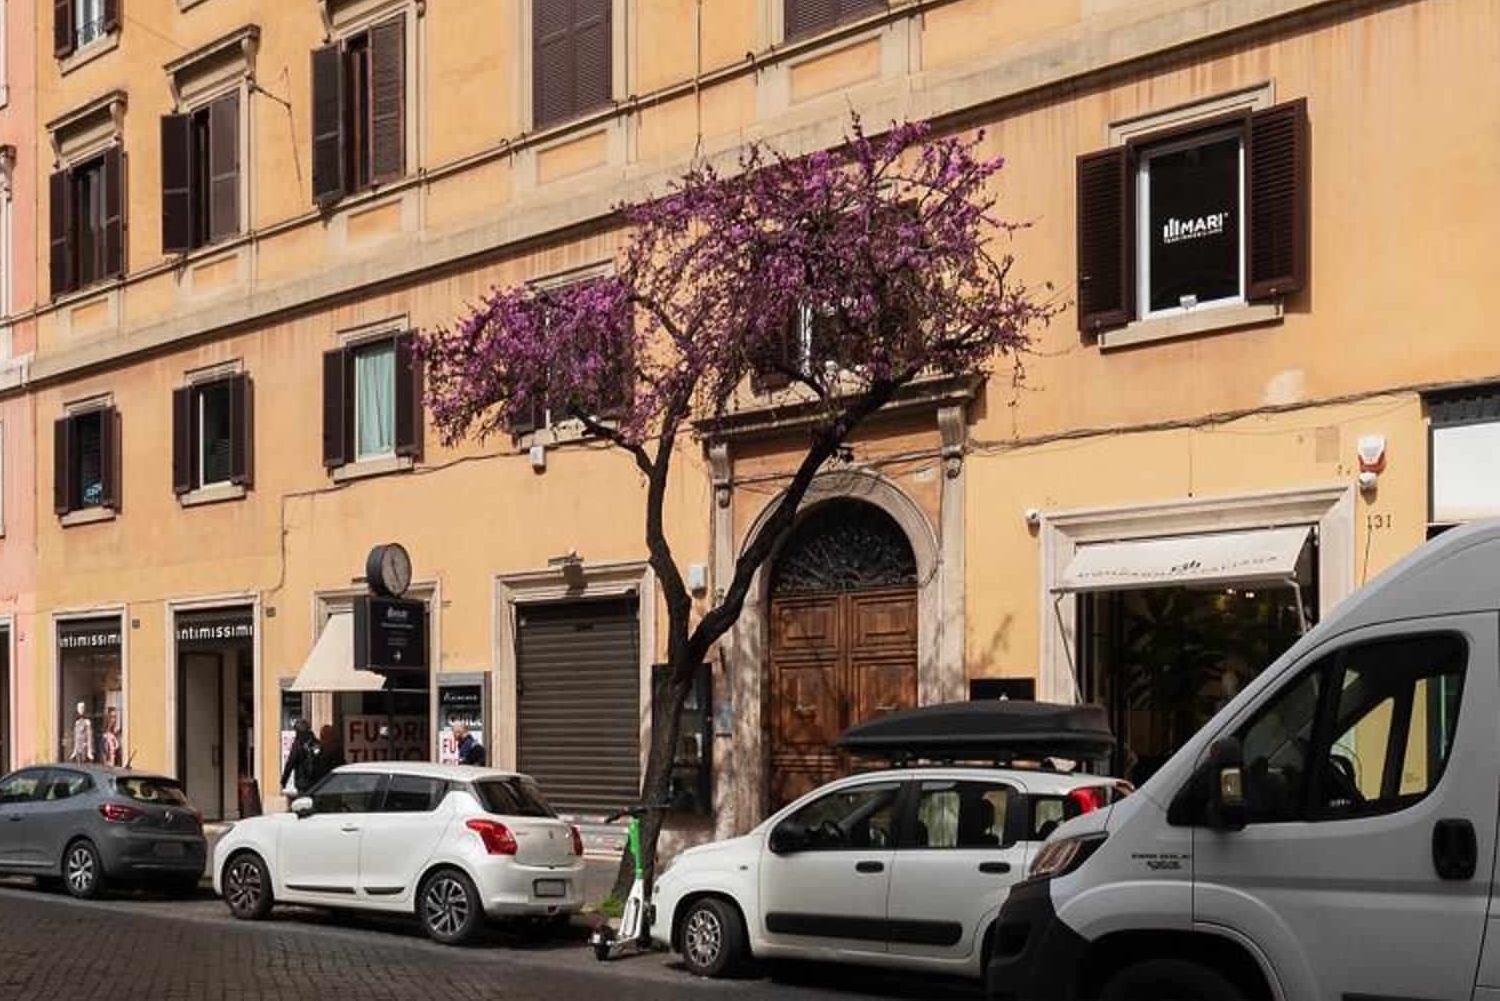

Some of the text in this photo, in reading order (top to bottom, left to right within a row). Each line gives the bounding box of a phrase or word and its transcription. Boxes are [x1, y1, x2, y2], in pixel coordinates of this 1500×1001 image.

[1180, 212, 1223, 235] MARI
[1367, 514, 1391, 529] 131
[175, 625, 253, 640] intimissimi
